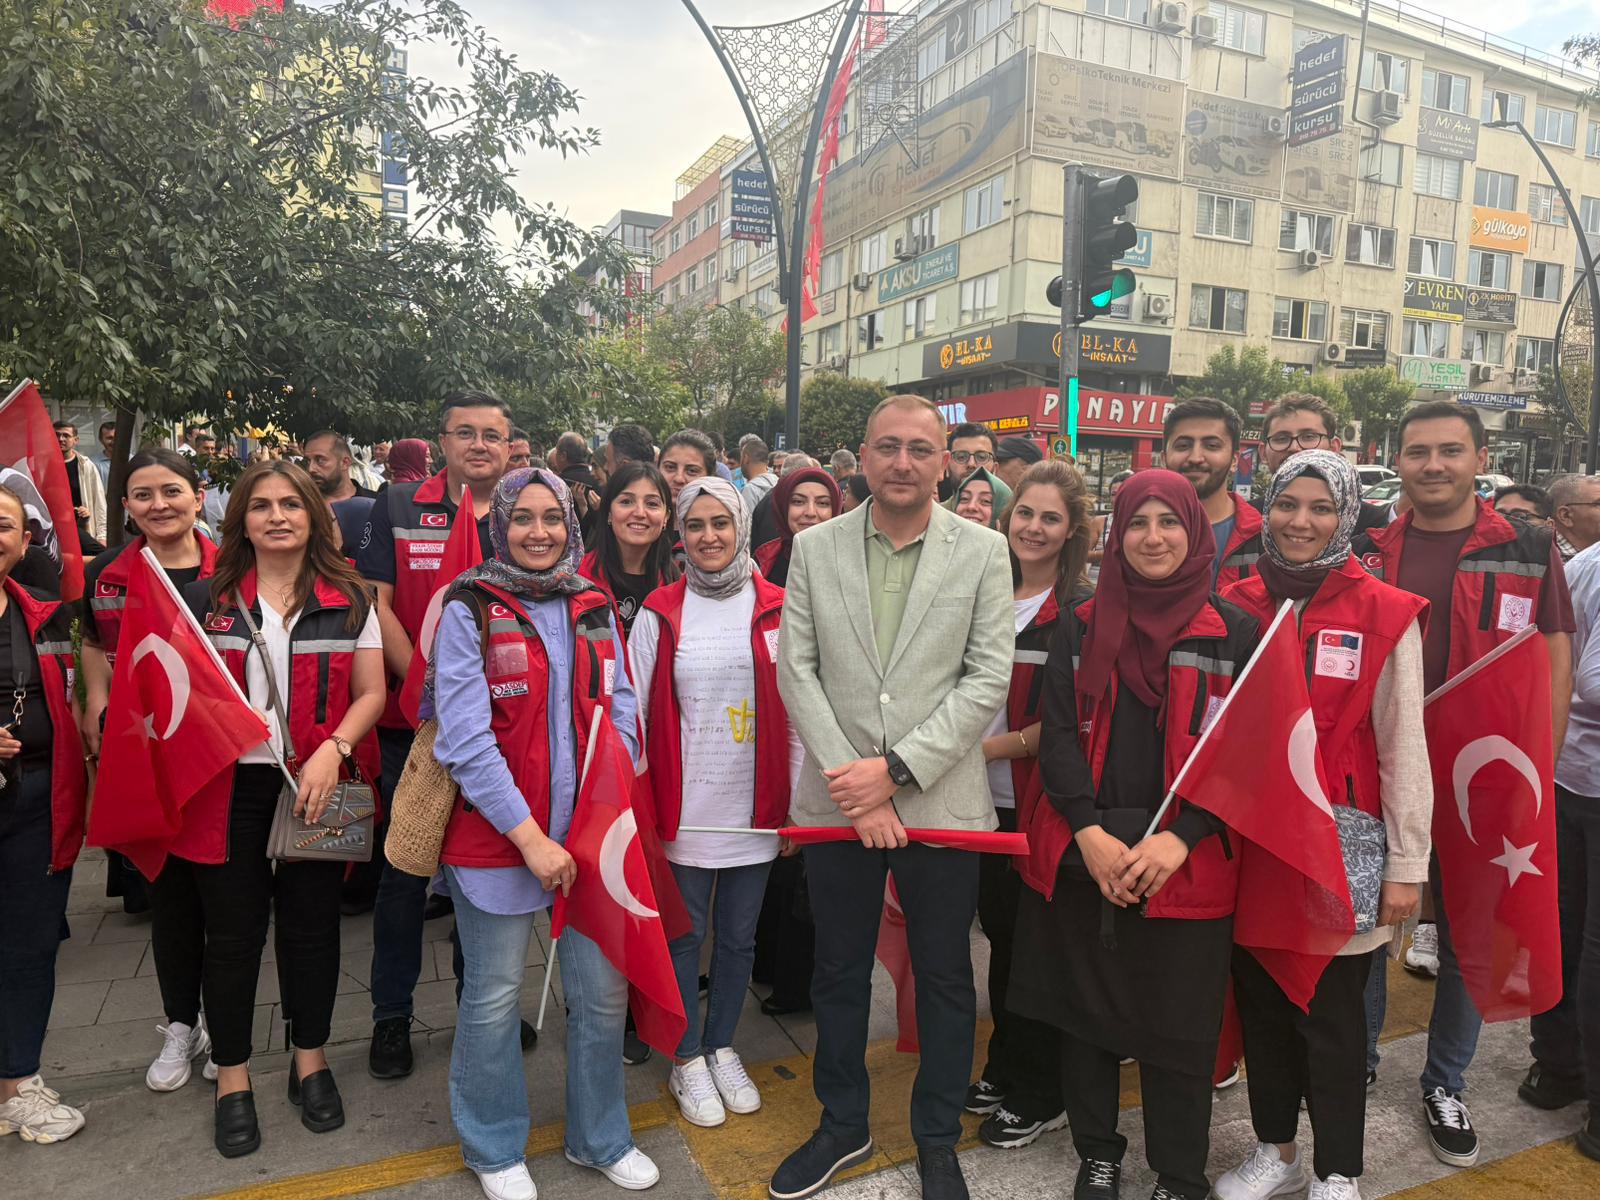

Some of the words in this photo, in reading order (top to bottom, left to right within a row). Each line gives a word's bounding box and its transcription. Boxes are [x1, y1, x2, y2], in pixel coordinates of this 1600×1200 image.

[1299, 48, 1337, 72] hedef
[1131, 77, 1172, 94] Merkezi
[1294, 81, 1337, 107] sürücü
[1294, 112, 1333, 134] kursu
[1329, 137, 1346, 149] SRC
[1328, 150, 1346, 161] SRC
[737, 177, 768, 190] hedef
[735, 203, 769, 215] sürücü
[735, 221, 767, 234] kursu
[1483, 219, 1527, 240] gülkaya
[890, 262, 922, 293] AKSU
[1417, 280, 1466, 301] EVREN
[1431, 299, 1450, 312] YAPI
[955, 334, 993, 357] EL-KA
[1081, 334, 1138, 354] EL-KA
[937, 402, 968, 425] YIR
[1043, 393, 1176, 425] PNAYIR
[504, 679, 528, 690] ASDEP
